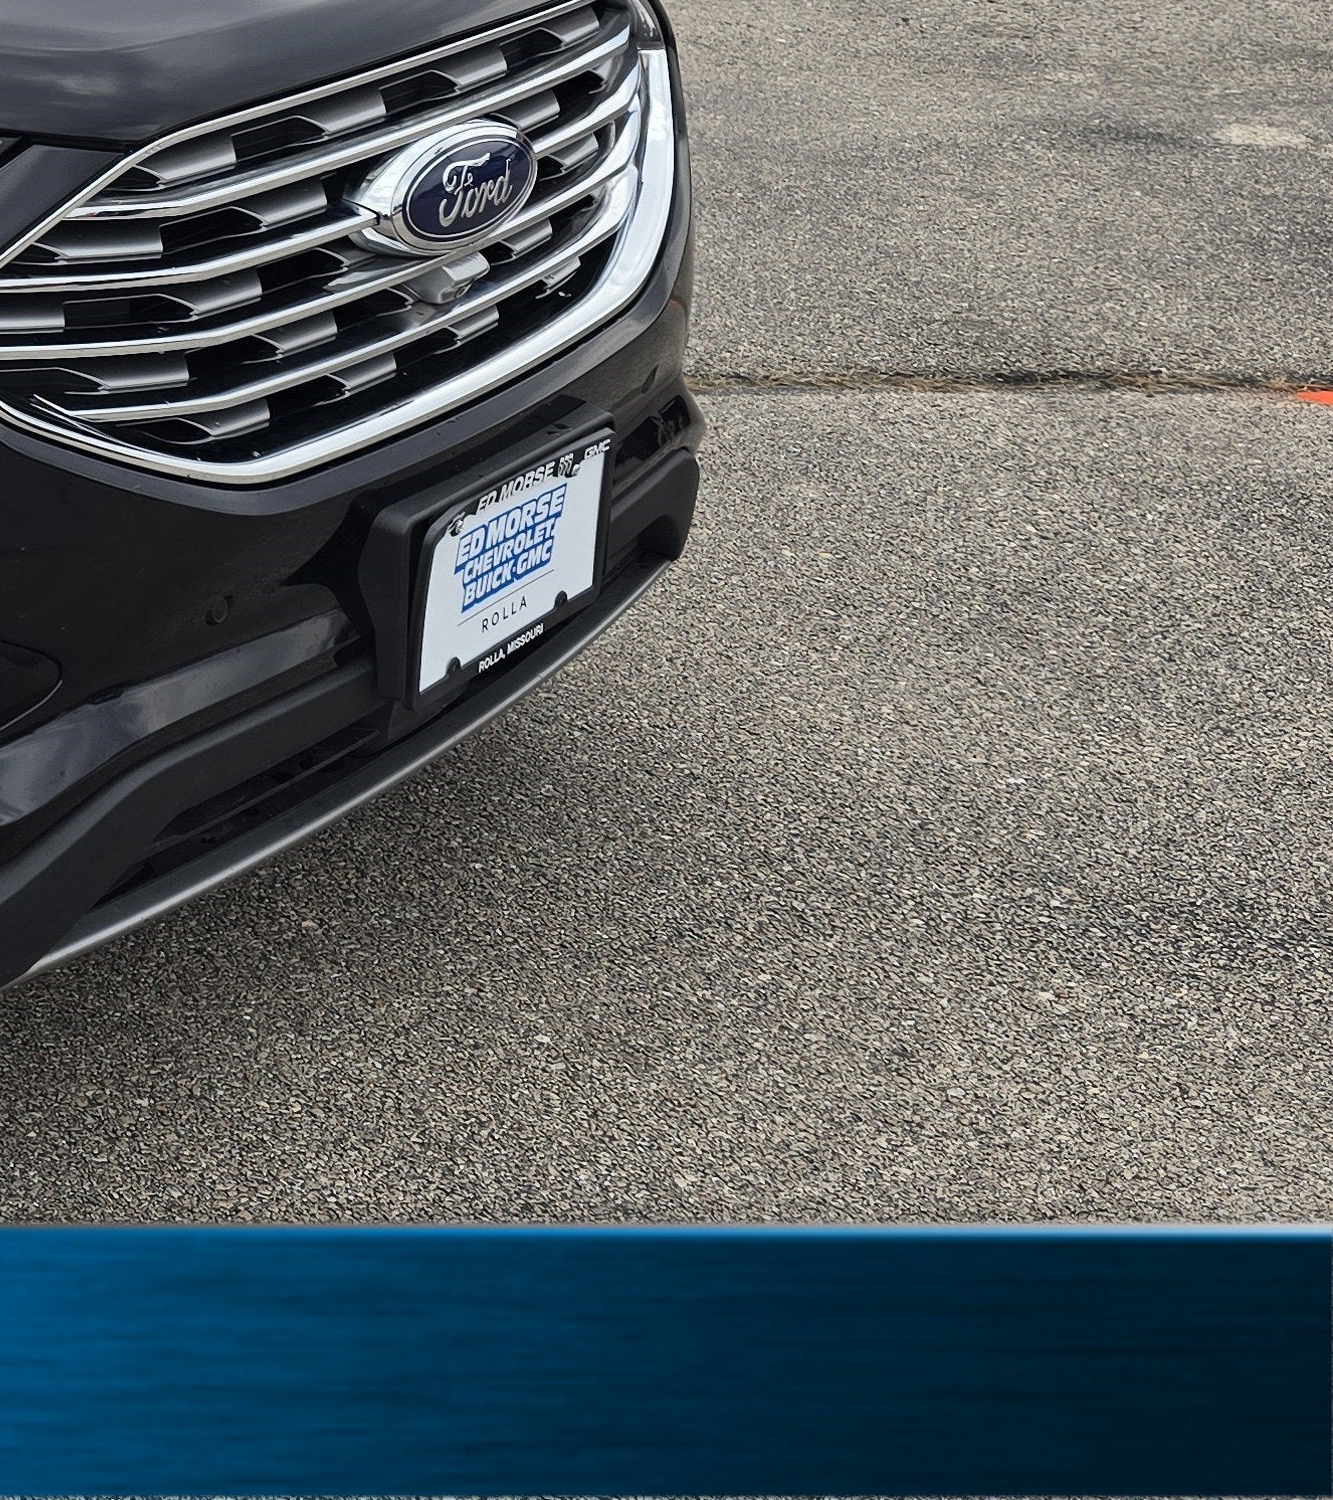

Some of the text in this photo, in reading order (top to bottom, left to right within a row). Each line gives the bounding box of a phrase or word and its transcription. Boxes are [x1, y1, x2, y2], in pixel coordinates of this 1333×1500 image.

[439, 152, 513, 227] Ford
[499, 461, 555, 501] MORSE
[455, 485, 566, 569] ED MORSE
[463, 518, 556, 585] CHEVROLET
[482, 595, 527, 633] ROLLA
[507, 623, 544, 655] MISSOURI
